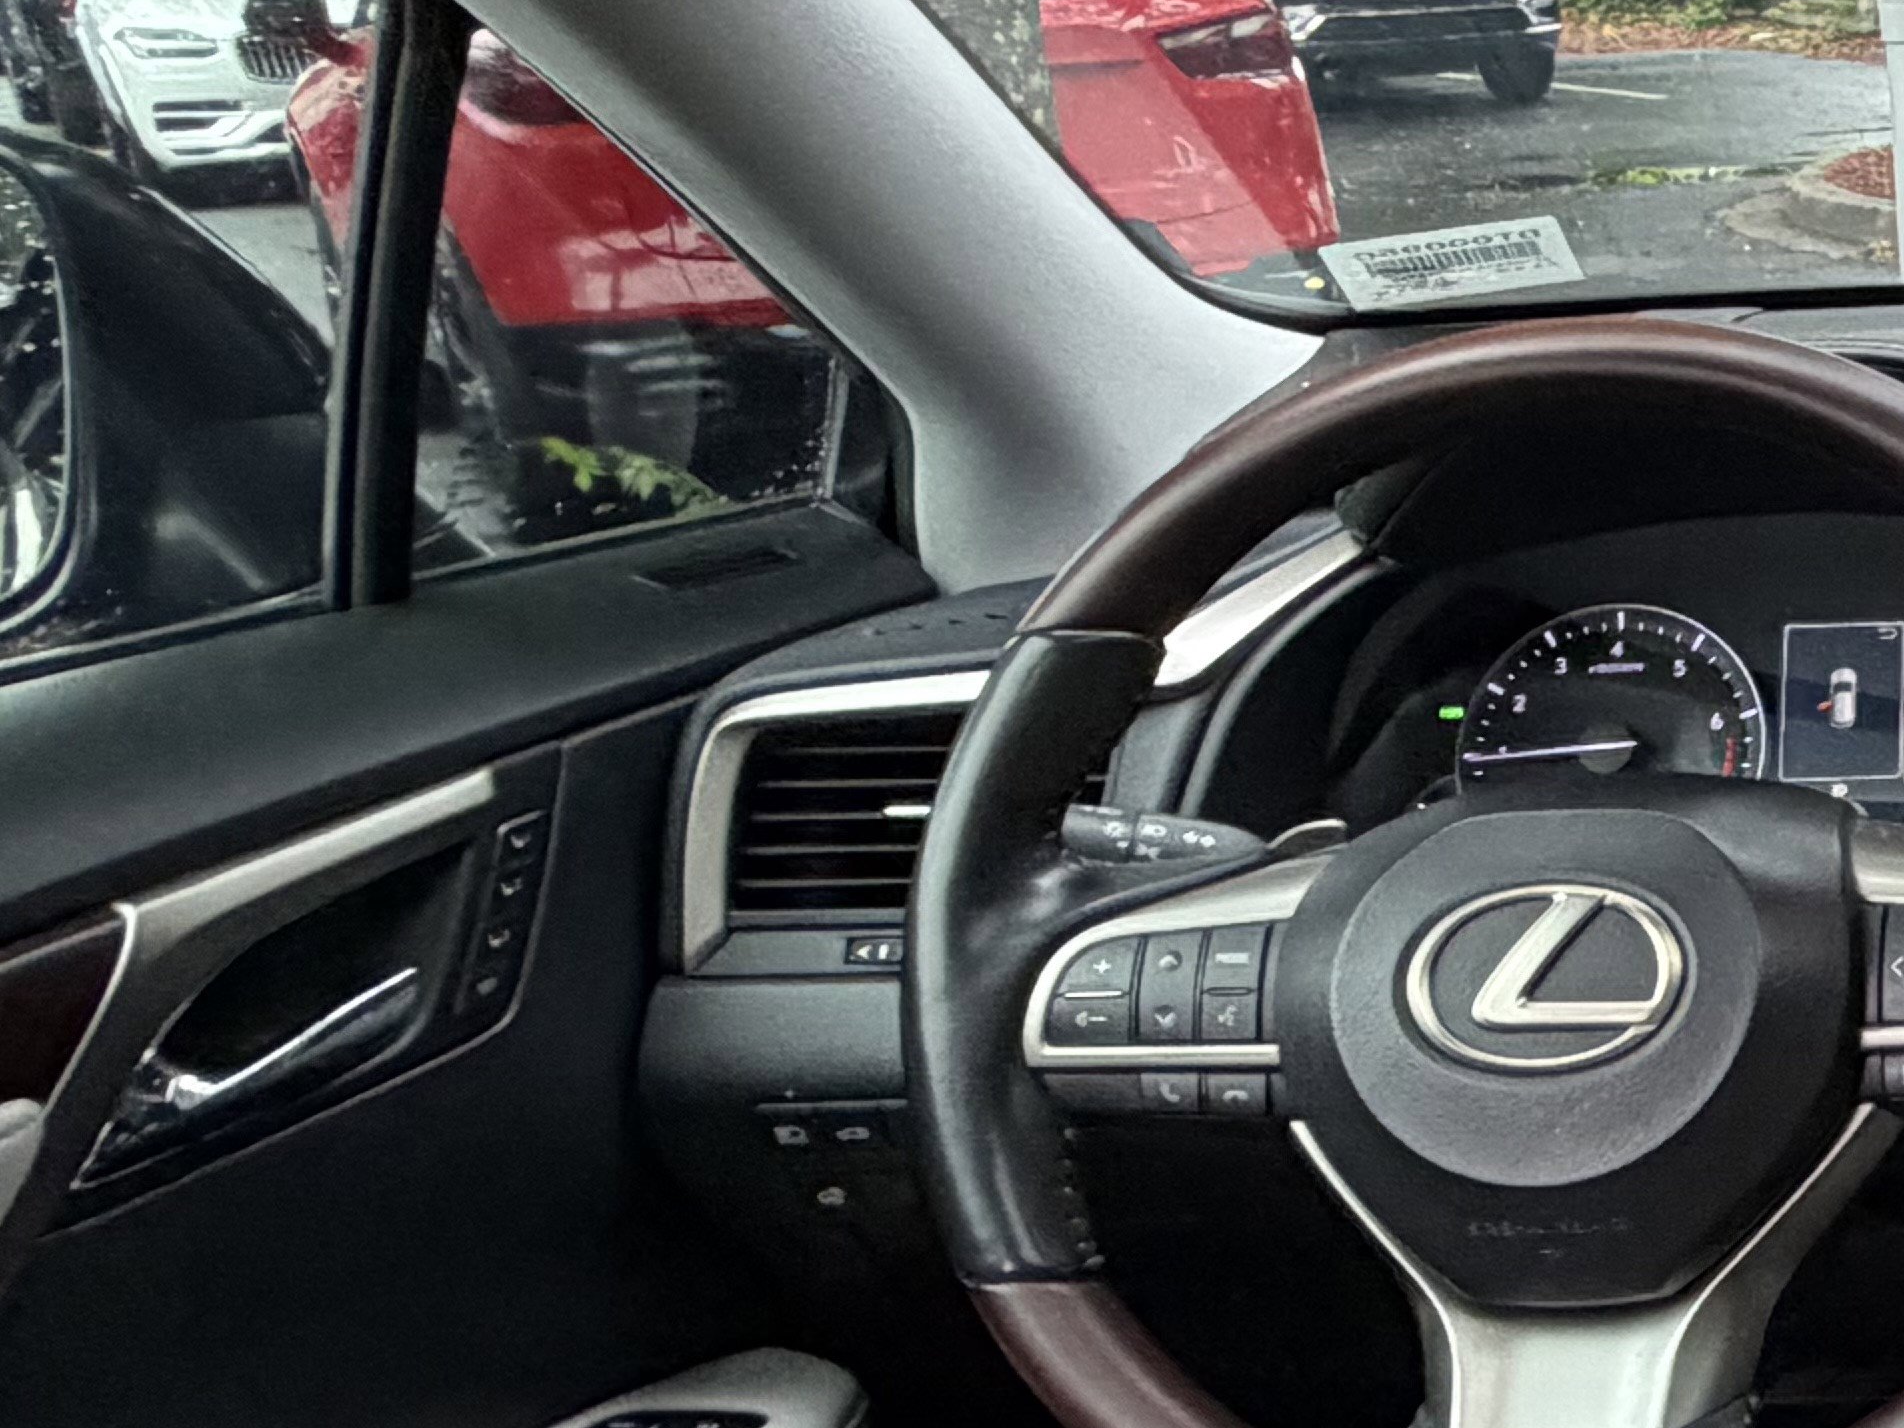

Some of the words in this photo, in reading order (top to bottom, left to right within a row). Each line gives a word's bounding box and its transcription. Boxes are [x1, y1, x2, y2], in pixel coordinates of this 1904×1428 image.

[1609, 640, 1625, 658] 4
[1554, 656, 1568, 676] 3
[1672, 658, 1688, 678] 5
[1512, 693, 1528, 714] 2
[1709, 711, 1725, 731] 6
